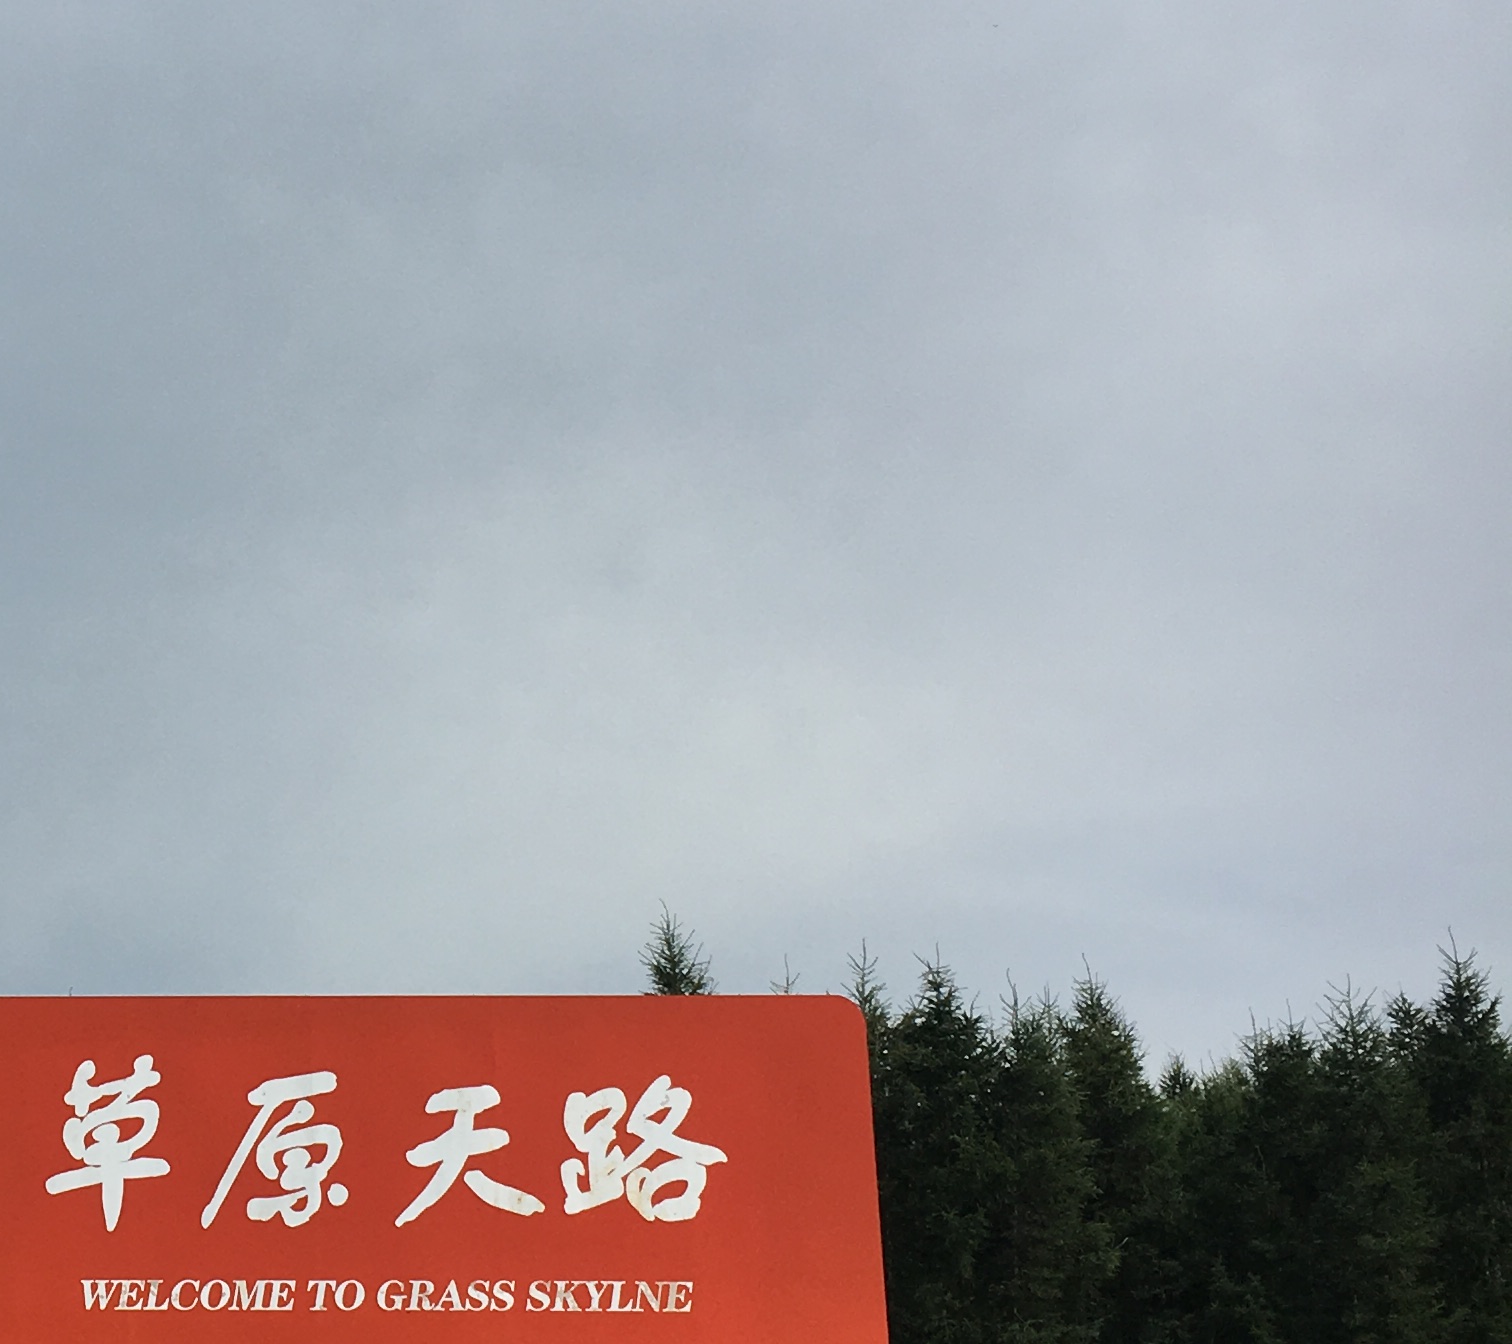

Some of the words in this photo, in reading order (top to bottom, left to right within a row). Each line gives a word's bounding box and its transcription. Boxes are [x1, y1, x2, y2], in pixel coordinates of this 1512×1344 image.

[45, 1054, 729, 1233] 草原天路
[80, 1279, 297, 1311] WELCOME
[306, 1279, 366, 1312] TO
[376, 1279, 516, 1312] GRASS
[525, 1280, 694, 1313] SKYLNE
